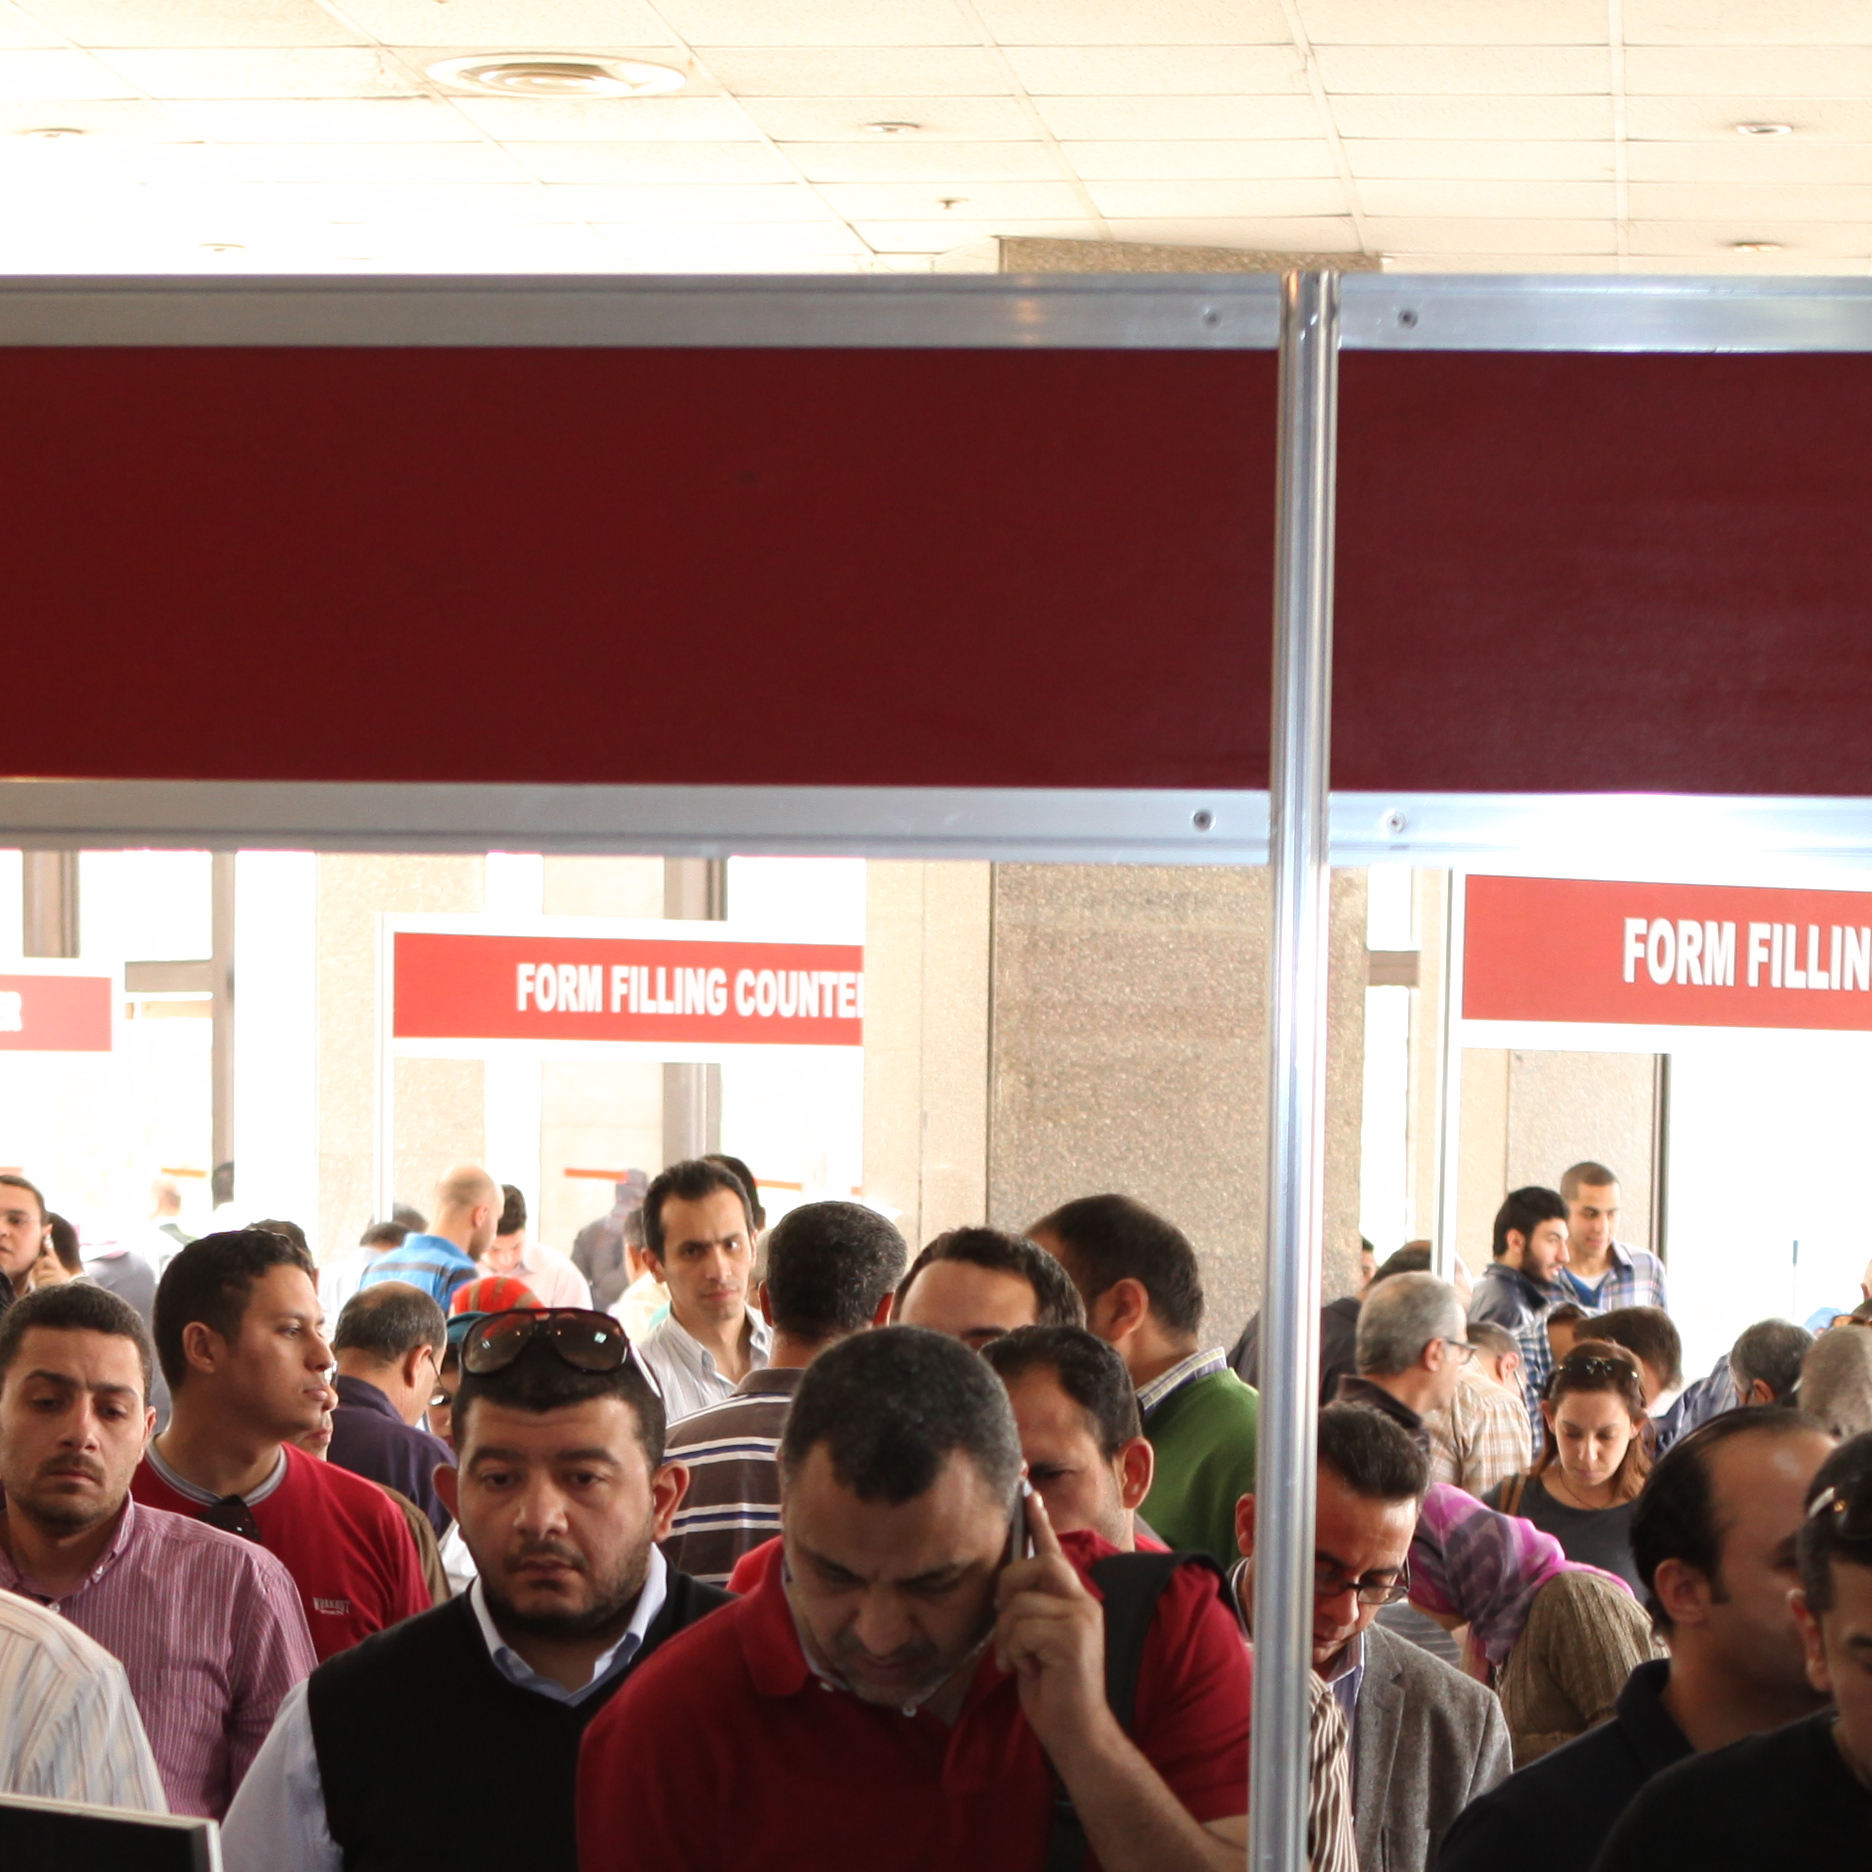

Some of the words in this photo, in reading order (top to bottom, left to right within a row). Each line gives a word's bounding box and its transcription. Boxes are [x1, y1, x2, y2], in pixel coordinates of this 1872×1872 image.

[1623, 916, 1736, 988] FORM
[515, 962, 604, 1013] FORM
[610, 964, 728, 1017] FILLING
